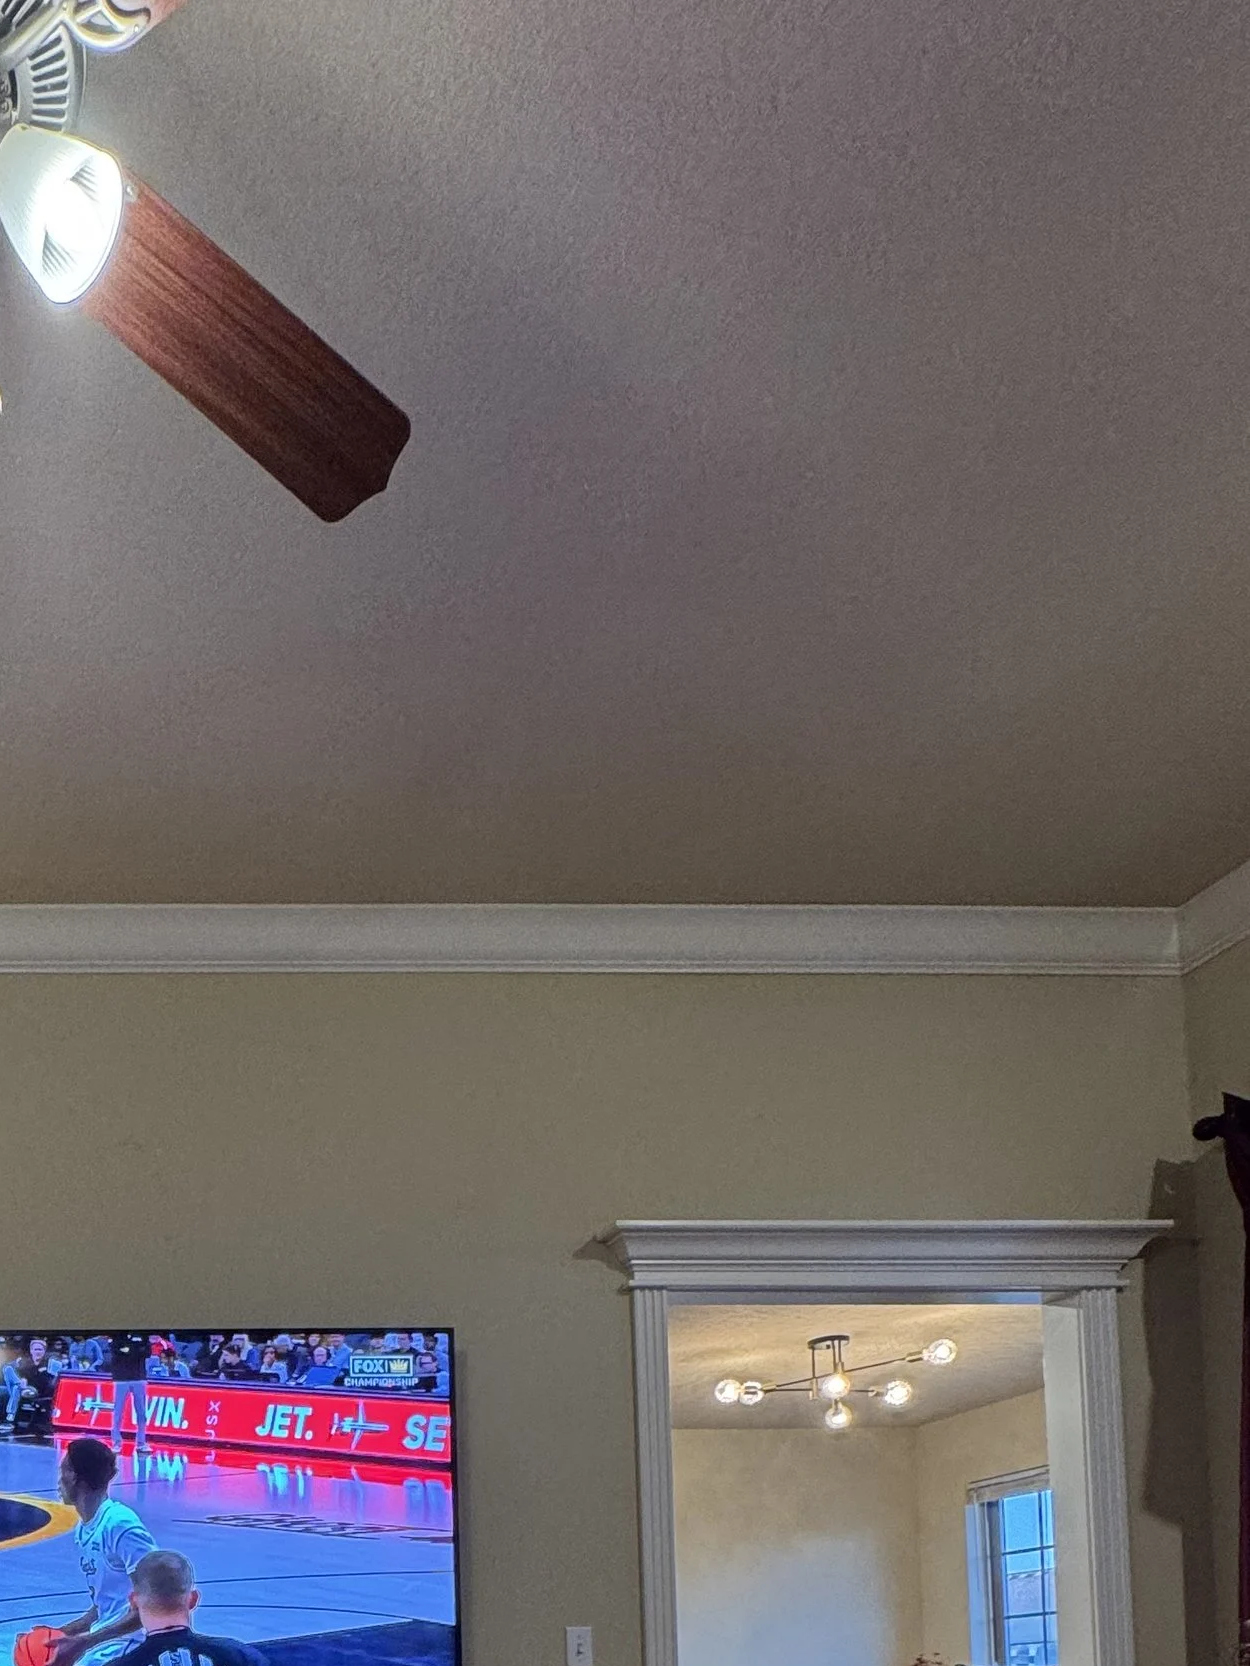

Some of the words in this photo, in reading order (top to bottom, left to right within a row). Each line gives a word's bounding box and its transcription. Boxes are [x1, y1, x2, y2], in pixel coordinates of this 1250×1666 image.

[353, 1359, 384, 1373] FOX
[344, 1377, 419, 1387] CHAMPIONSHIP
[255, 1404, 313, 1440] JET.
